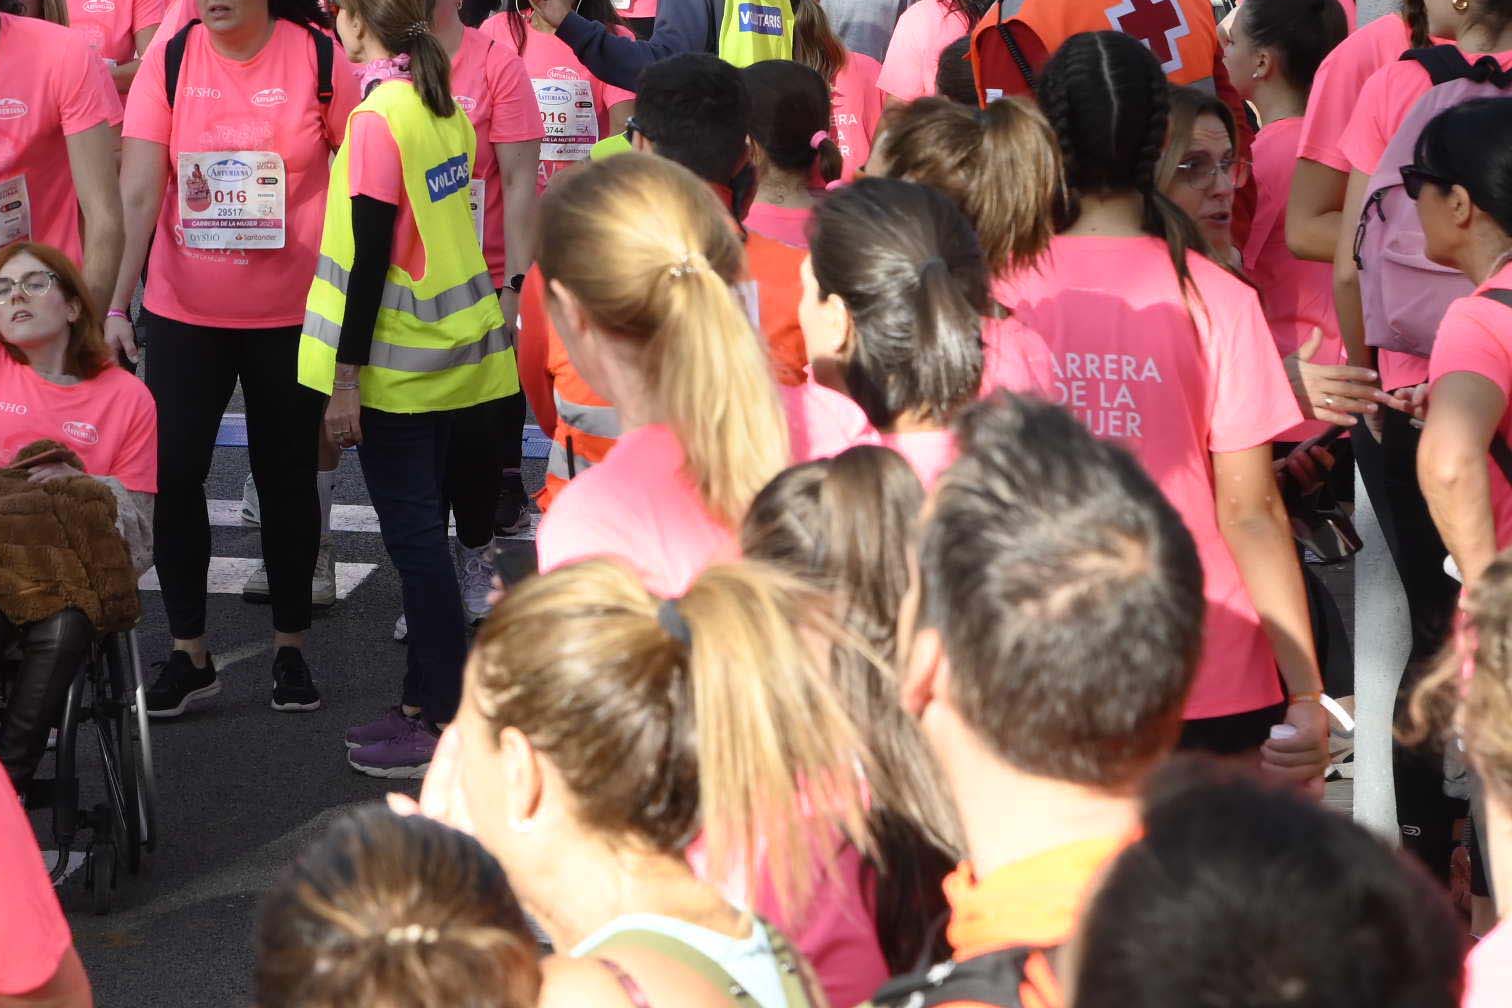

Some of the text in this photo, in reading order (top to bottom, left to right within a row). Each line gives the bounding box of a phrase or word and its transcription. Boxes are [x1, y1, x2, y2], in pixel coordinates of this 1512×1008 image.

[214, 190, 247, 204] 016
[217, 207, 243, 217] 29517
[1099, 383, 1136, 408] LA
